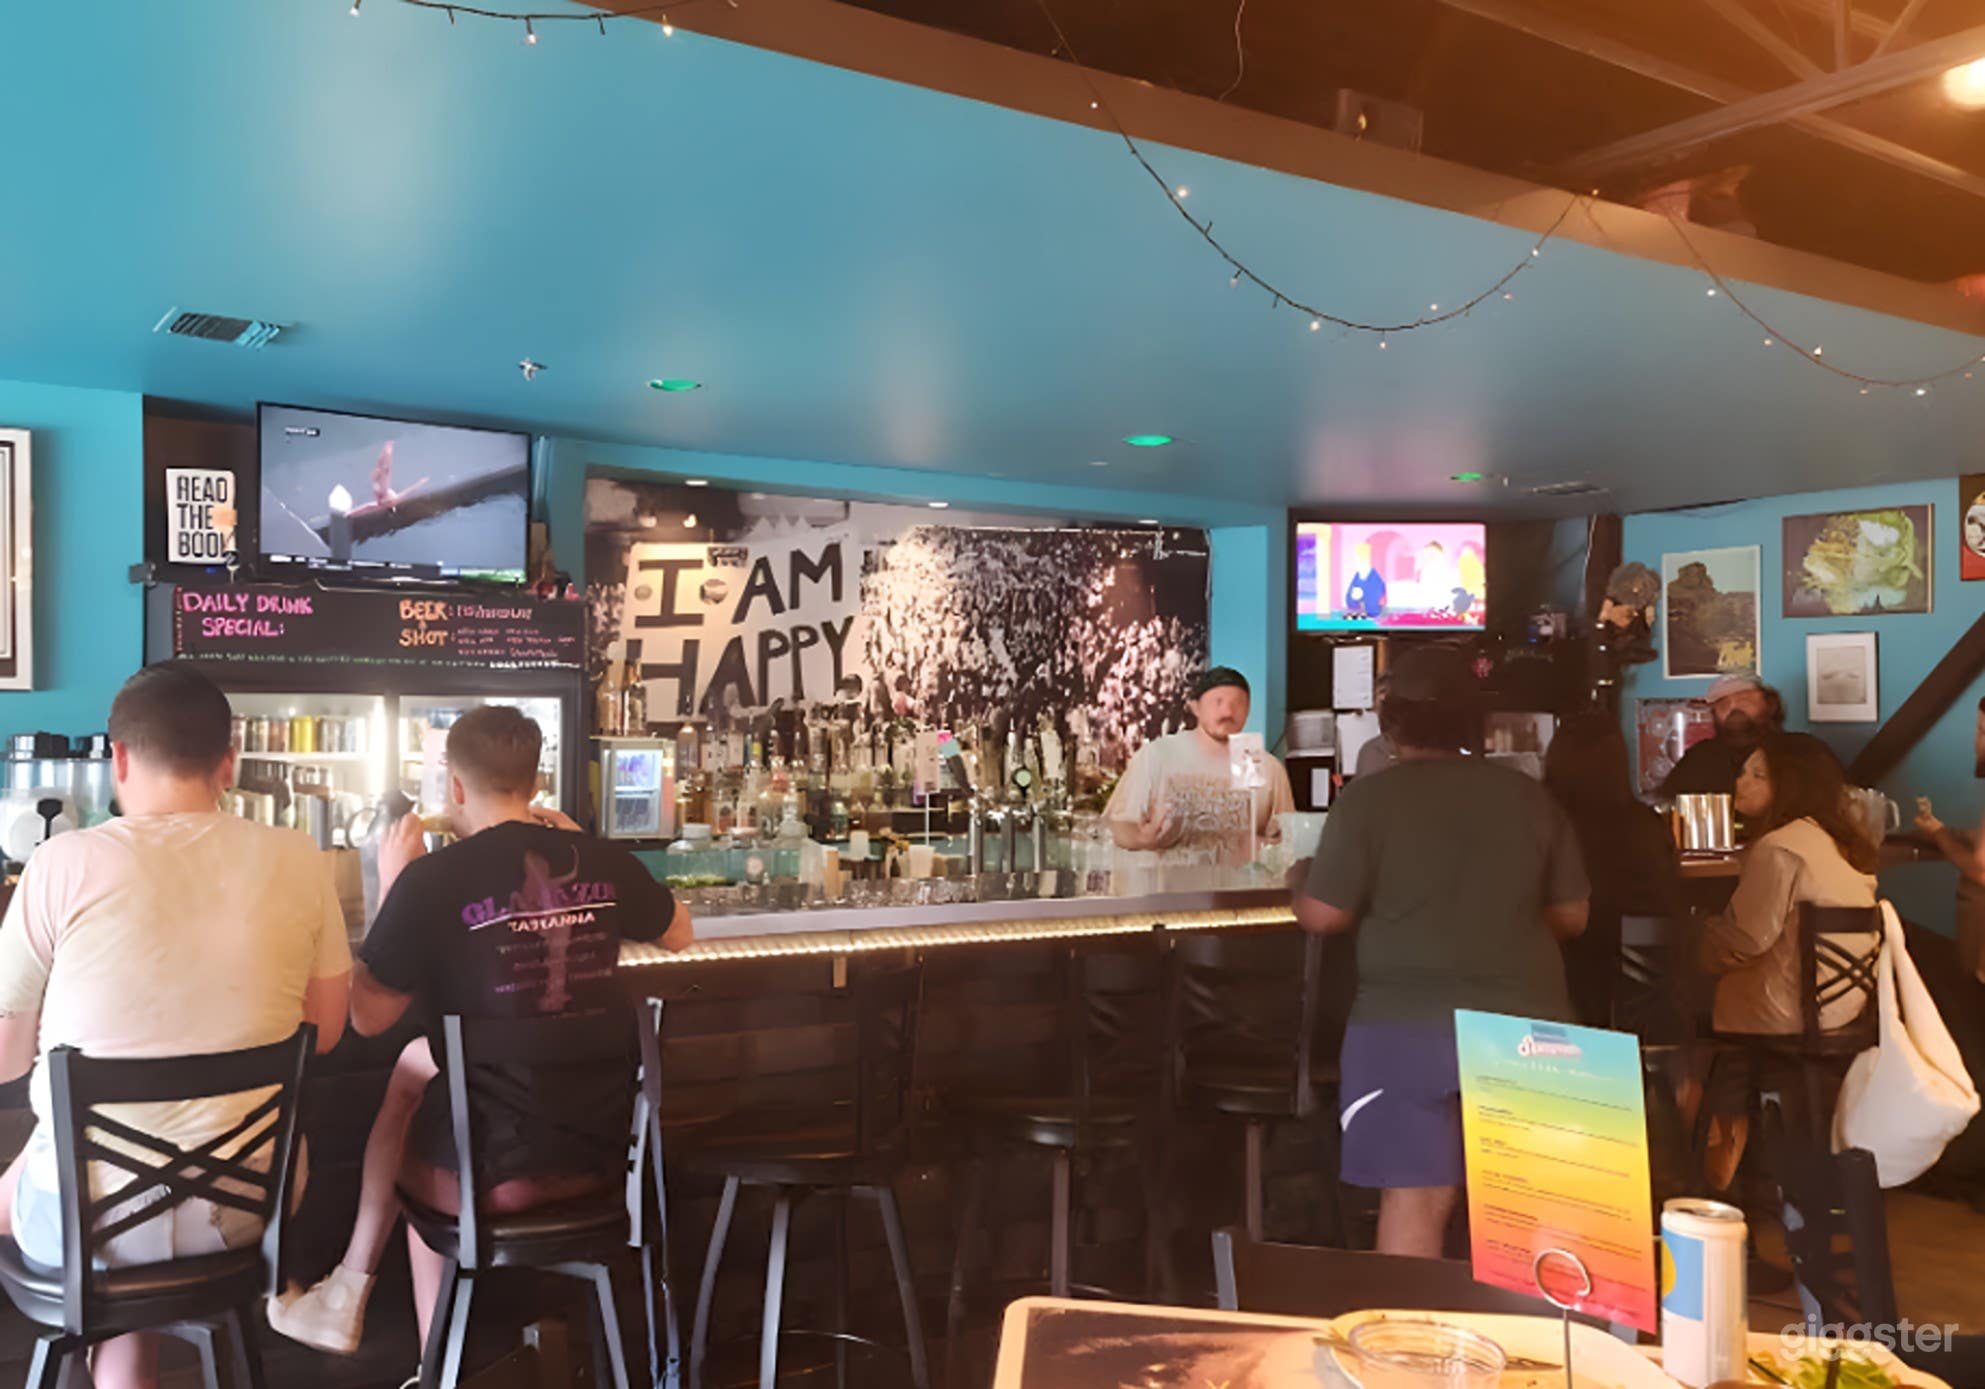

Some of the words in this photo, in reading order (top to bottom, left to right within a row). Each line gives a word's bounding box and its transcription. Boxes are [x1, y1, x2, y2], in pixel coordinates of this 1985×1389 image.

[176, 476, 228, 503] READ
[176, 503, 215, 530] THE
[635, 559, 704, 628] I
[731, 542, 844, 624] AM
[182, 592, 249, 613] DAILY
[256, 595, 314, 615] DRINK
[202, 617, 285, 638] SPECIAL:
[625, 615, 855, 717] HAPPY
